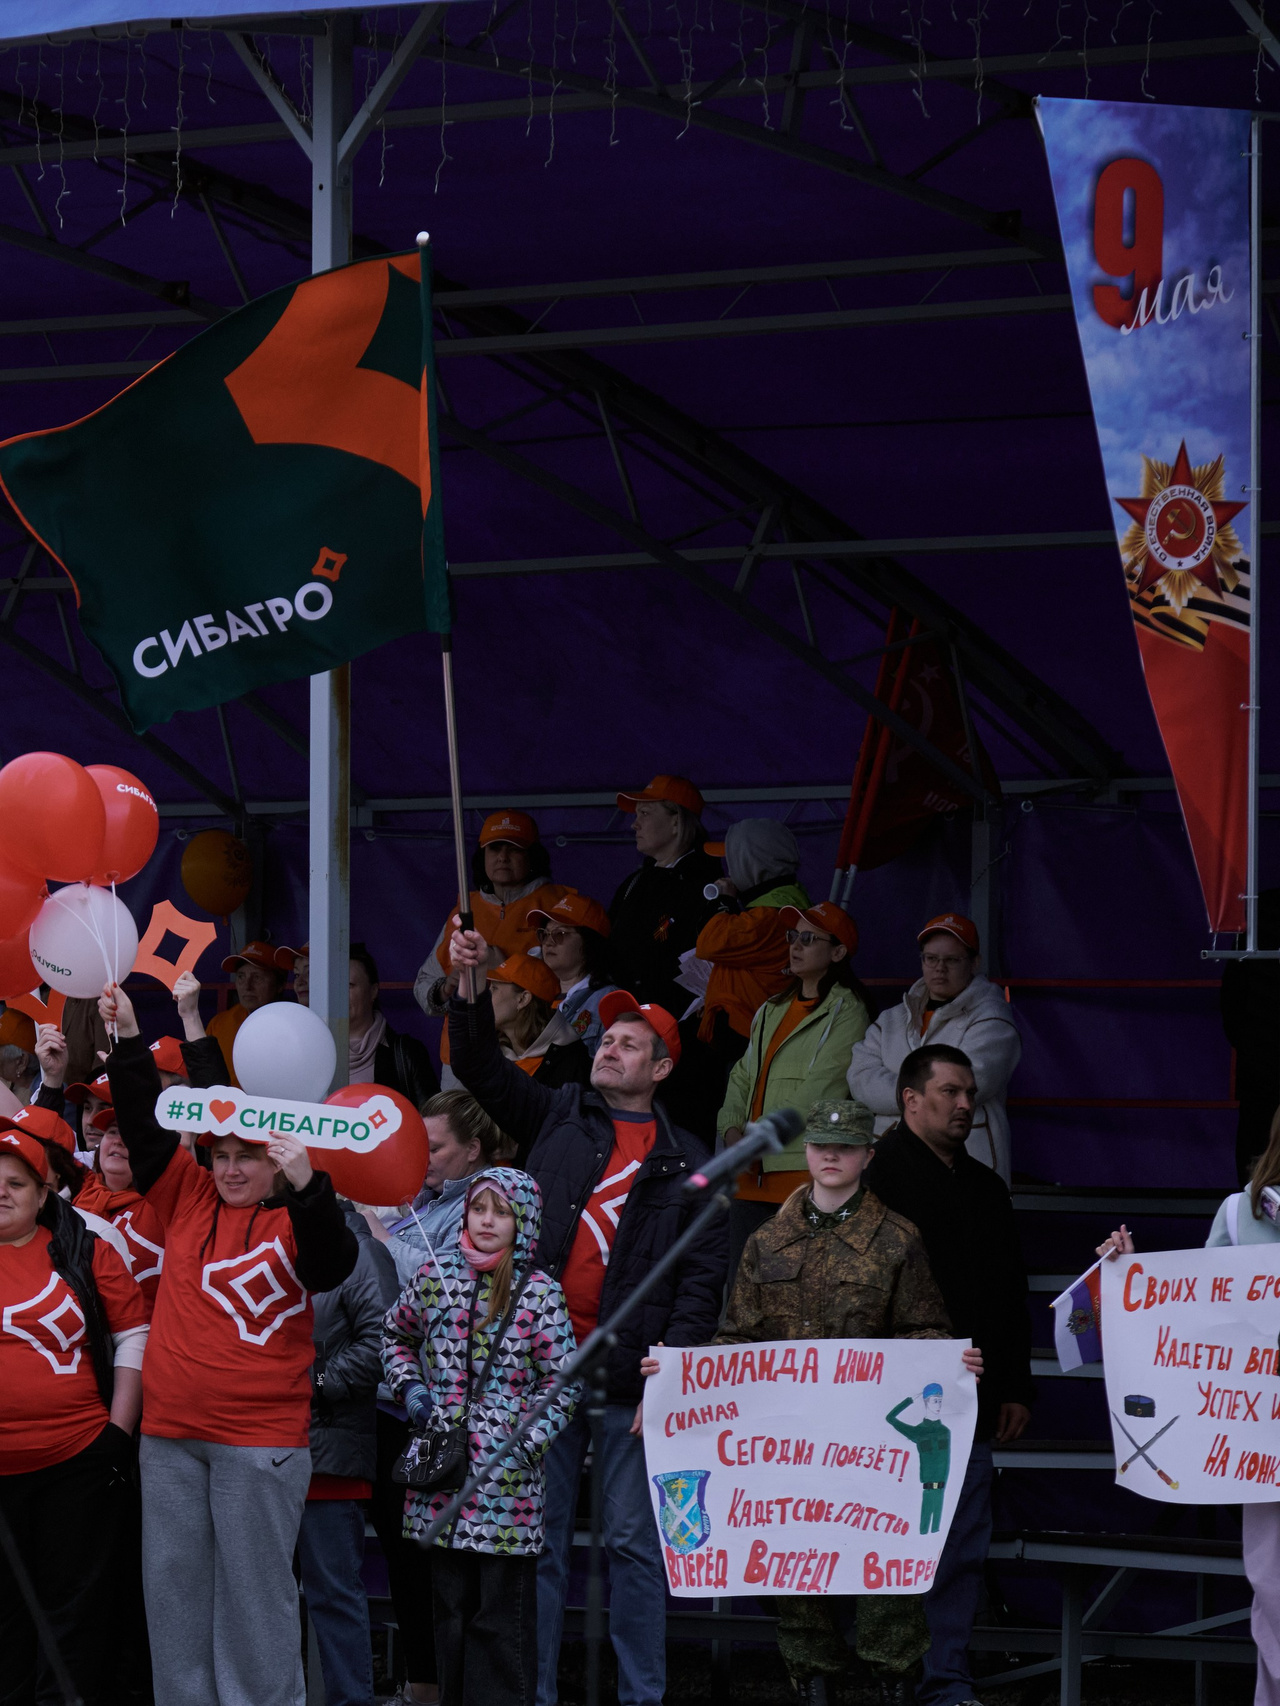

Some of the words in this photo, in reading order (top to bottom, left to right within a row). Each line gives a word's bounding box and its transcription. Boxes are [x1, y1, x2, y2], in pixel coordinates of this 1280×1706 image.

[1093, 158, 1164, 329] 9
[1149, 487, 1210, 562] ОТЕЧЕСТВЕННАЯ
[133, 581, 333, 678] СИБАГРО
[32, 949, 72, 976] СИБАГРО
[166, 1100, 203, 1121] #Я
[239, 1108, 370, 1141] СИБАГРО
[1123, 1262, 1197, 1312] СВОИХ
[1211, 1277, 1234, 1302] НЕ
[681, 1347, 818, 1395] КОМАНДА
[1154, 1325, 1233, 1371] КАДЕТЫ
[1197, 1381, 1262, 1422] УСПЕХ
[717, 1429, 815, 1467] СЕГОДНЯ
[822, 1442, 910, 1483] ПОВЕЗЁТ!
[1203, 1433, 1231, 1477] НА
[1234, 1450, 1280, 1487] КОНК
